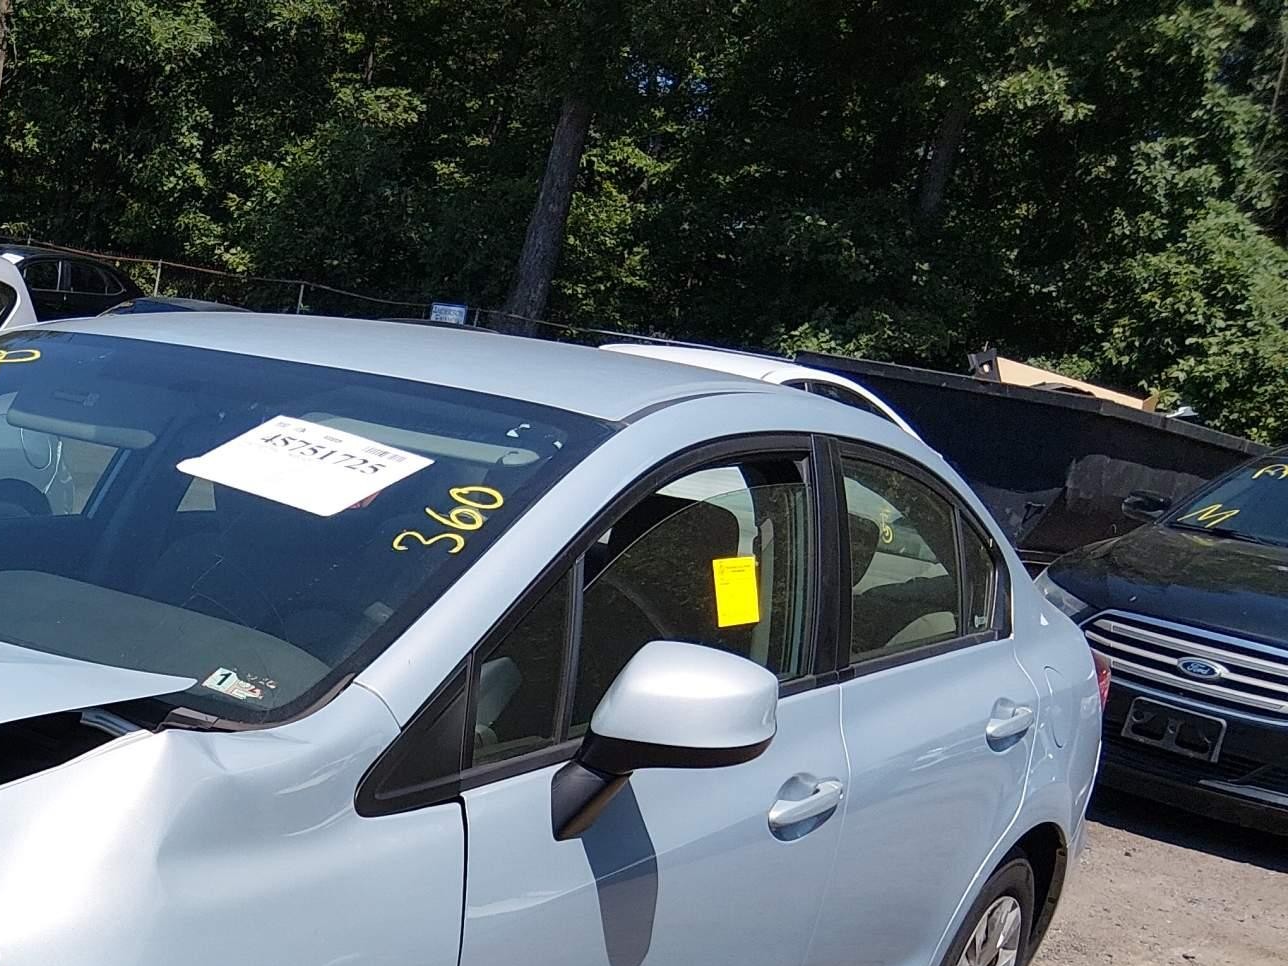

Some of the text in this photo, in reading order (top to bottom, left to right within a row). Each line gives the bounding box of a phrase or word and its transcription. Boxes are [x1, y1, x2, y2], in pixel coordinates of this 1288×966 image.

[260, 433, 387, 475] 45751725
[392, 485, 505, 554] 360
[217, 672, 233, 687] 1
